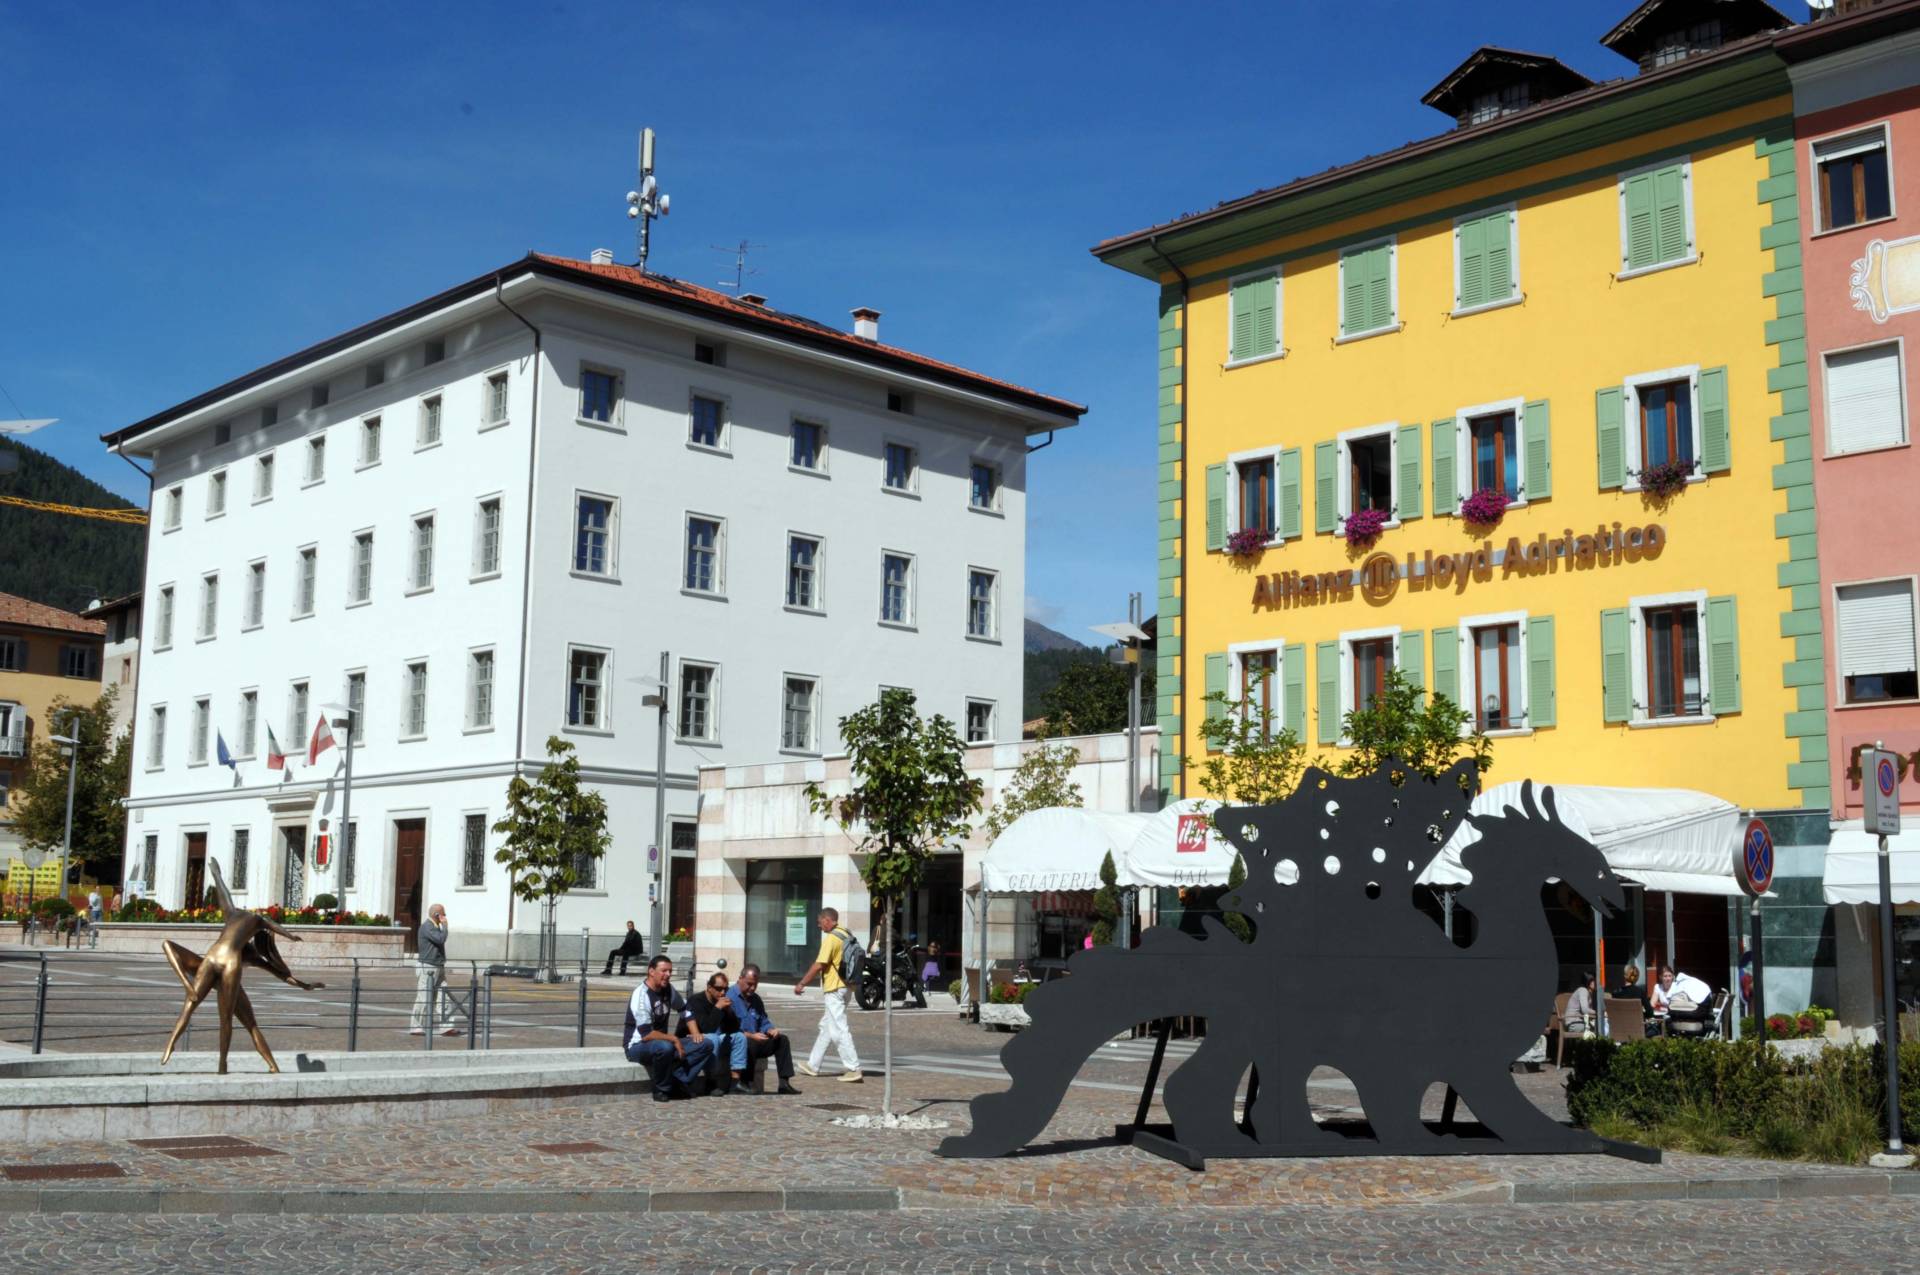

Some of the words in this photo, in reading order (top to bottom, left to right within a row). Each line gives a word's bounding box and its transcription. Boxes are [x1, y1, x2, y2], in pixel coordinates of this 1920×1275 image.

[1251, 569, 1354, 609] Allianz
[1407, 541, 1493, 590] Lloyd
[1502, 521, 1667, 577] Adriatico
[1008, 871, 1098, 889] GELATERIA
[1173, 868, 1208, 883] BAR
